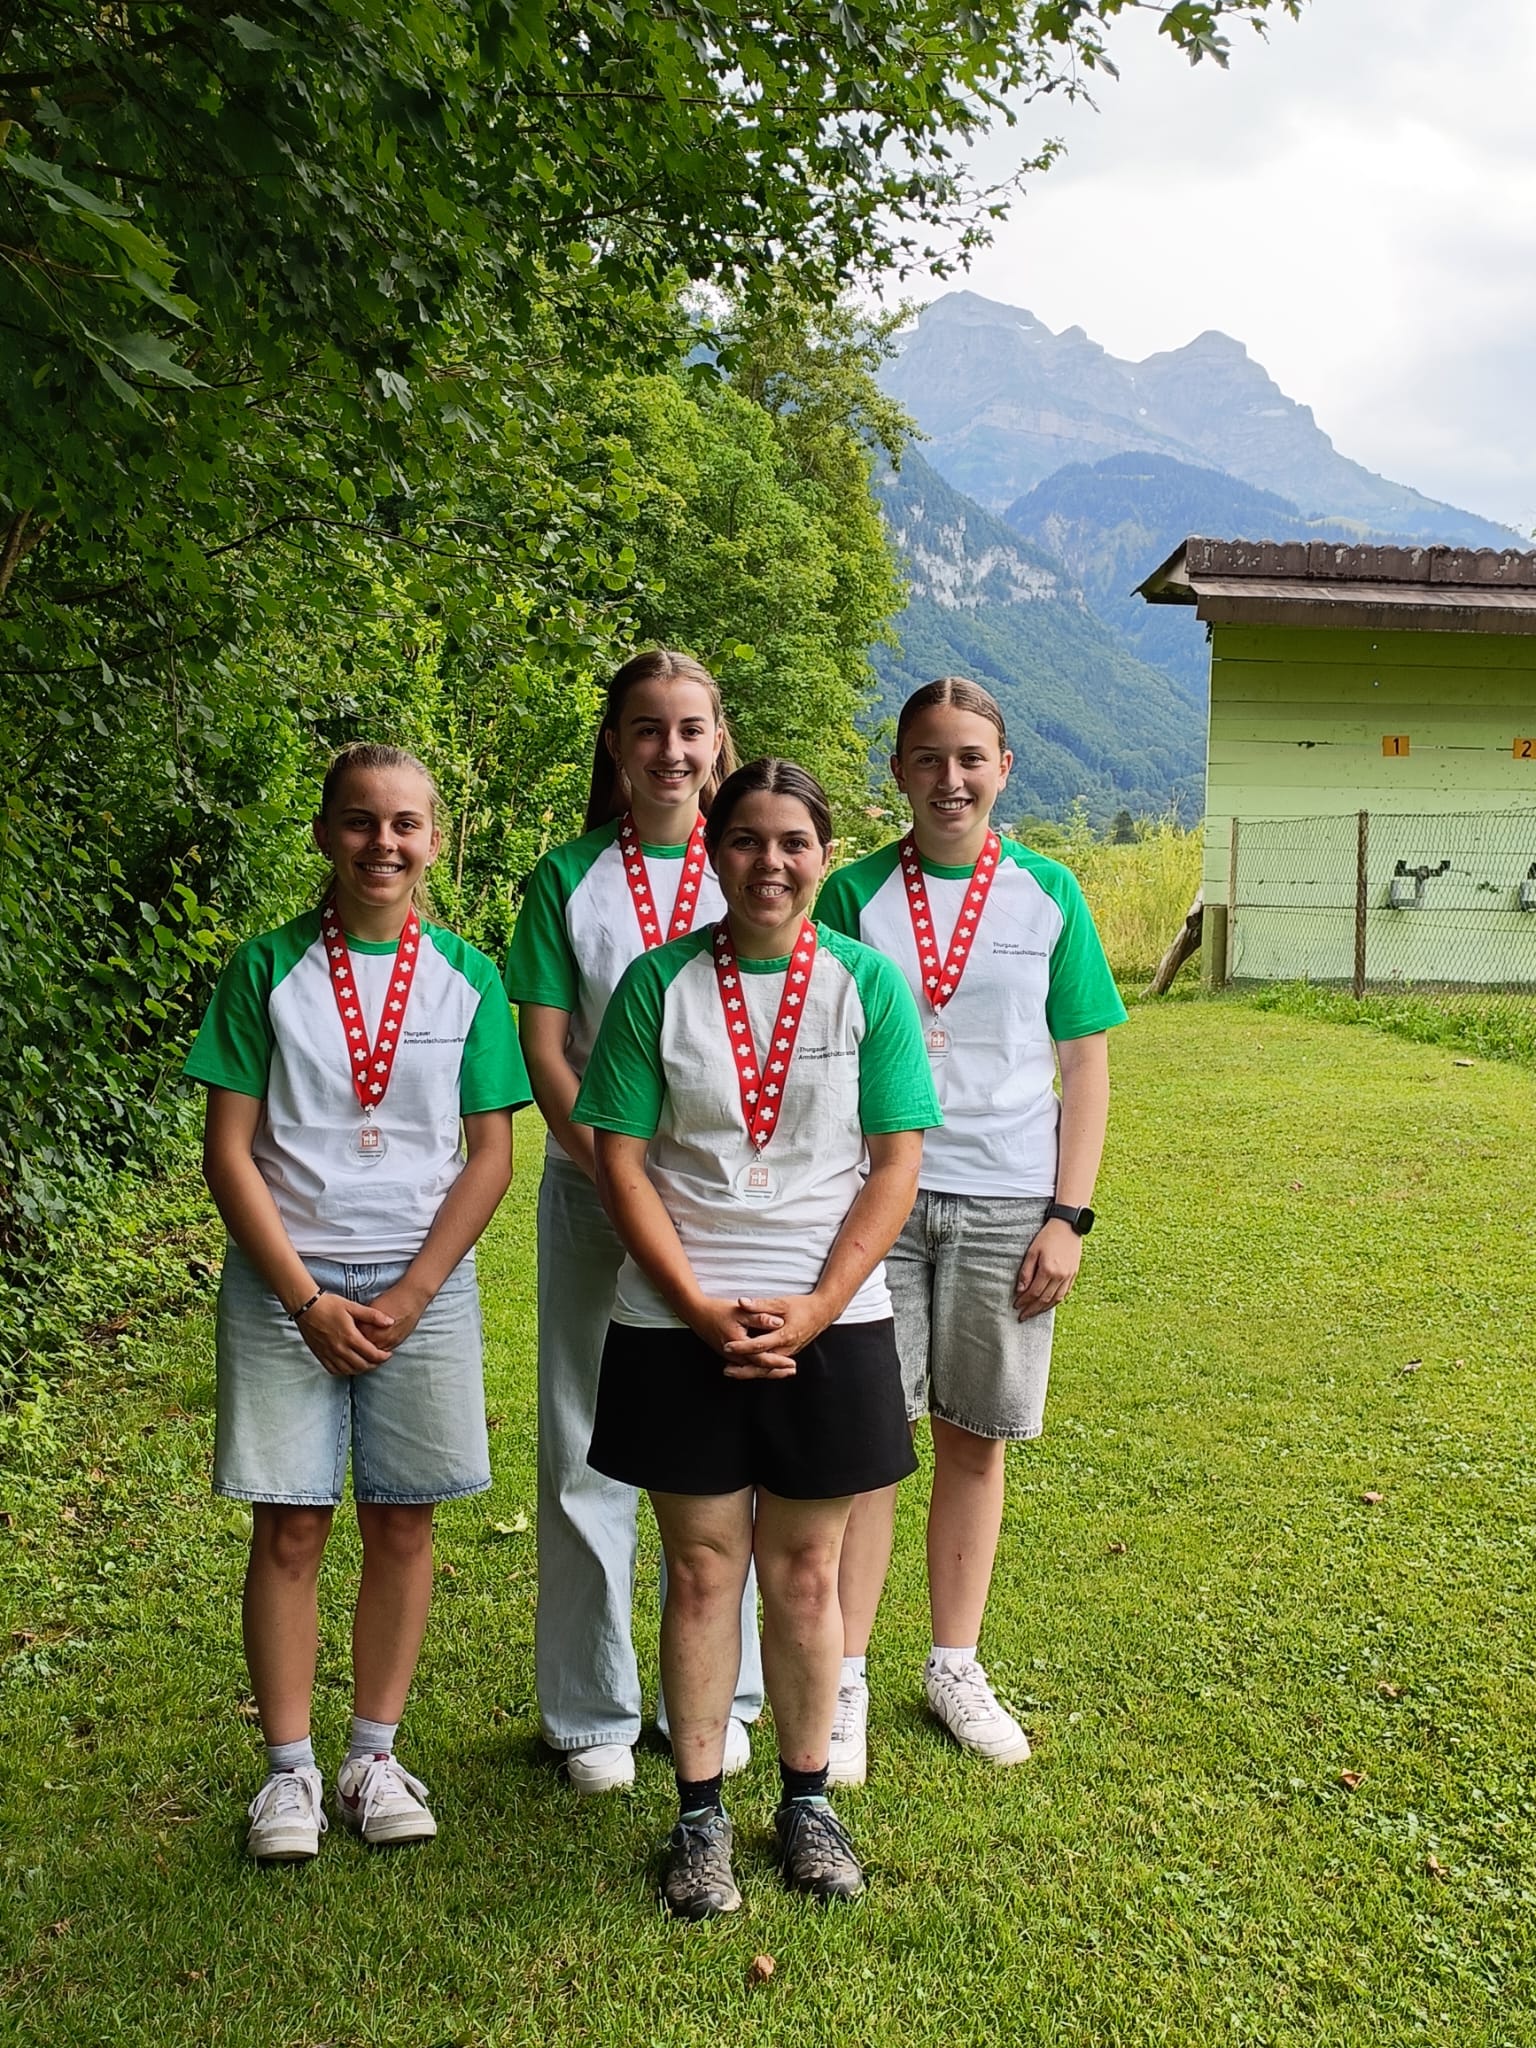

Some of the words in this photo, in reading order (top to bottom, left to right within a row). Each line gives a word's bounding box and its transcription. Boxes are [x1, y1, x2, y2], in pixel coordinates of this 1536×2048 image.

[1392, 736, 1400, 756] 1
[1521, 740, 1532, 758] 2
[992, 941, 1019, 949] Thurgauer
[403, 1030, 431, 1038] Thurgauer
